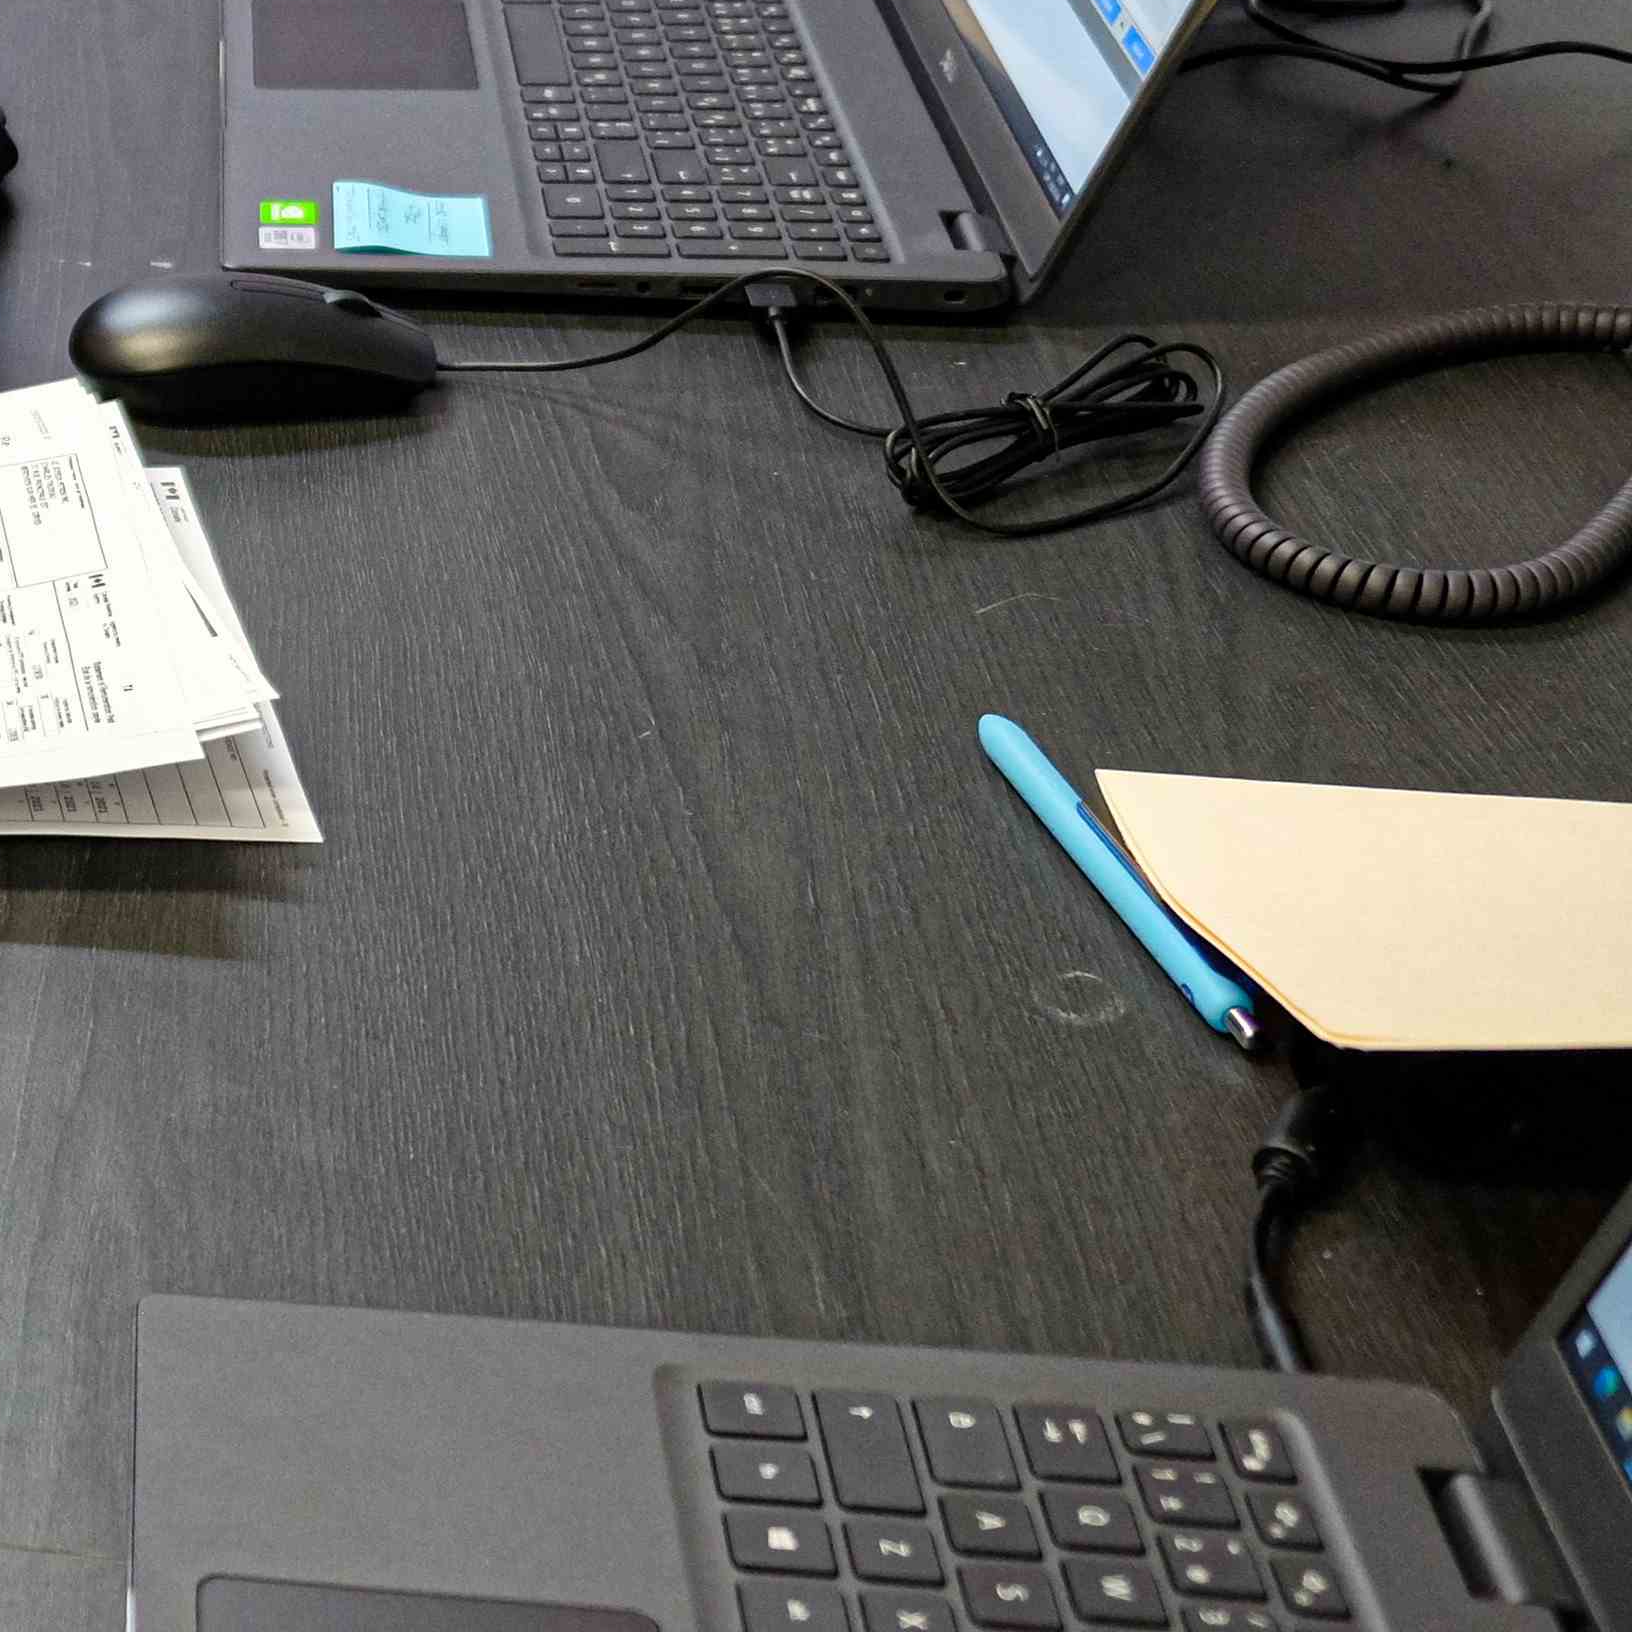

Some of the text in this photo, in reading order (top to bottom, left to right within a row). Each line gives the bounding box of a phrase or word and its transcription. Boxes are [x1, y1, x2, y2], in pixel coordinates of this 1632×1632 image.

[974, 1511, 1006, 1531] A
[1077, 1504, 1111, 1527] Q
[878, 1538, 912, 1558] Z
[1173, 1535, 1203, 1553] 2
[995, 1583, 1029, 1602] S
[1101, 1574, 1133, 1602] W
[896, 1611, 928, 1631] X
